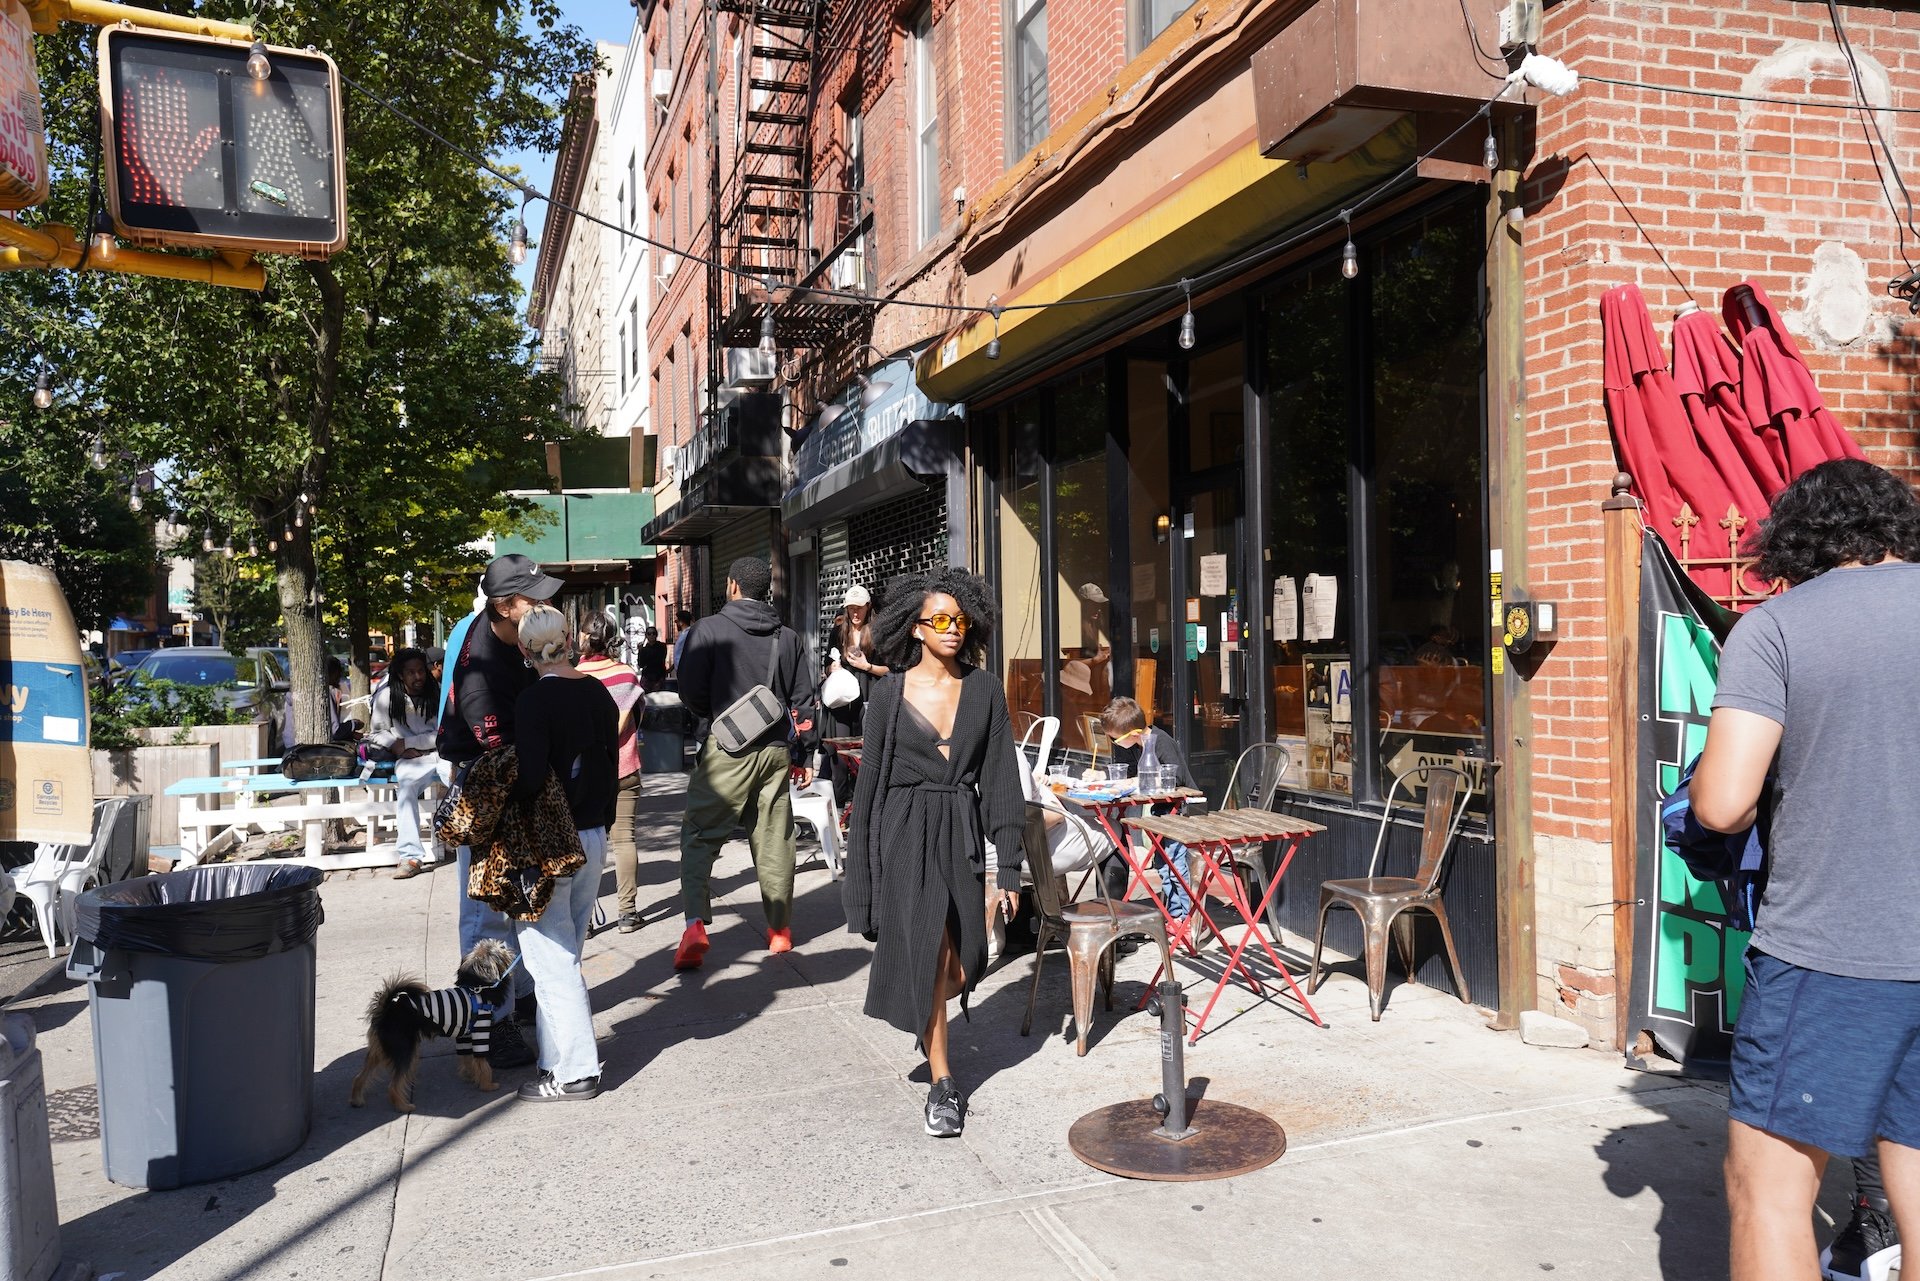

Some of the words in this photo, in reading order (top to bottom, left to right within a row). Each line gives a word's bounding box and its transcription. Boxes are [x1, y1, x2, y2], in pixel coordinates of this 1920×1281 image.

[867, 392, 917, 447] BUTTER
[1, 606, 19, 619] May
[20, 607, 31, 618] Be
[32, 608, 52, 621] Heavy
